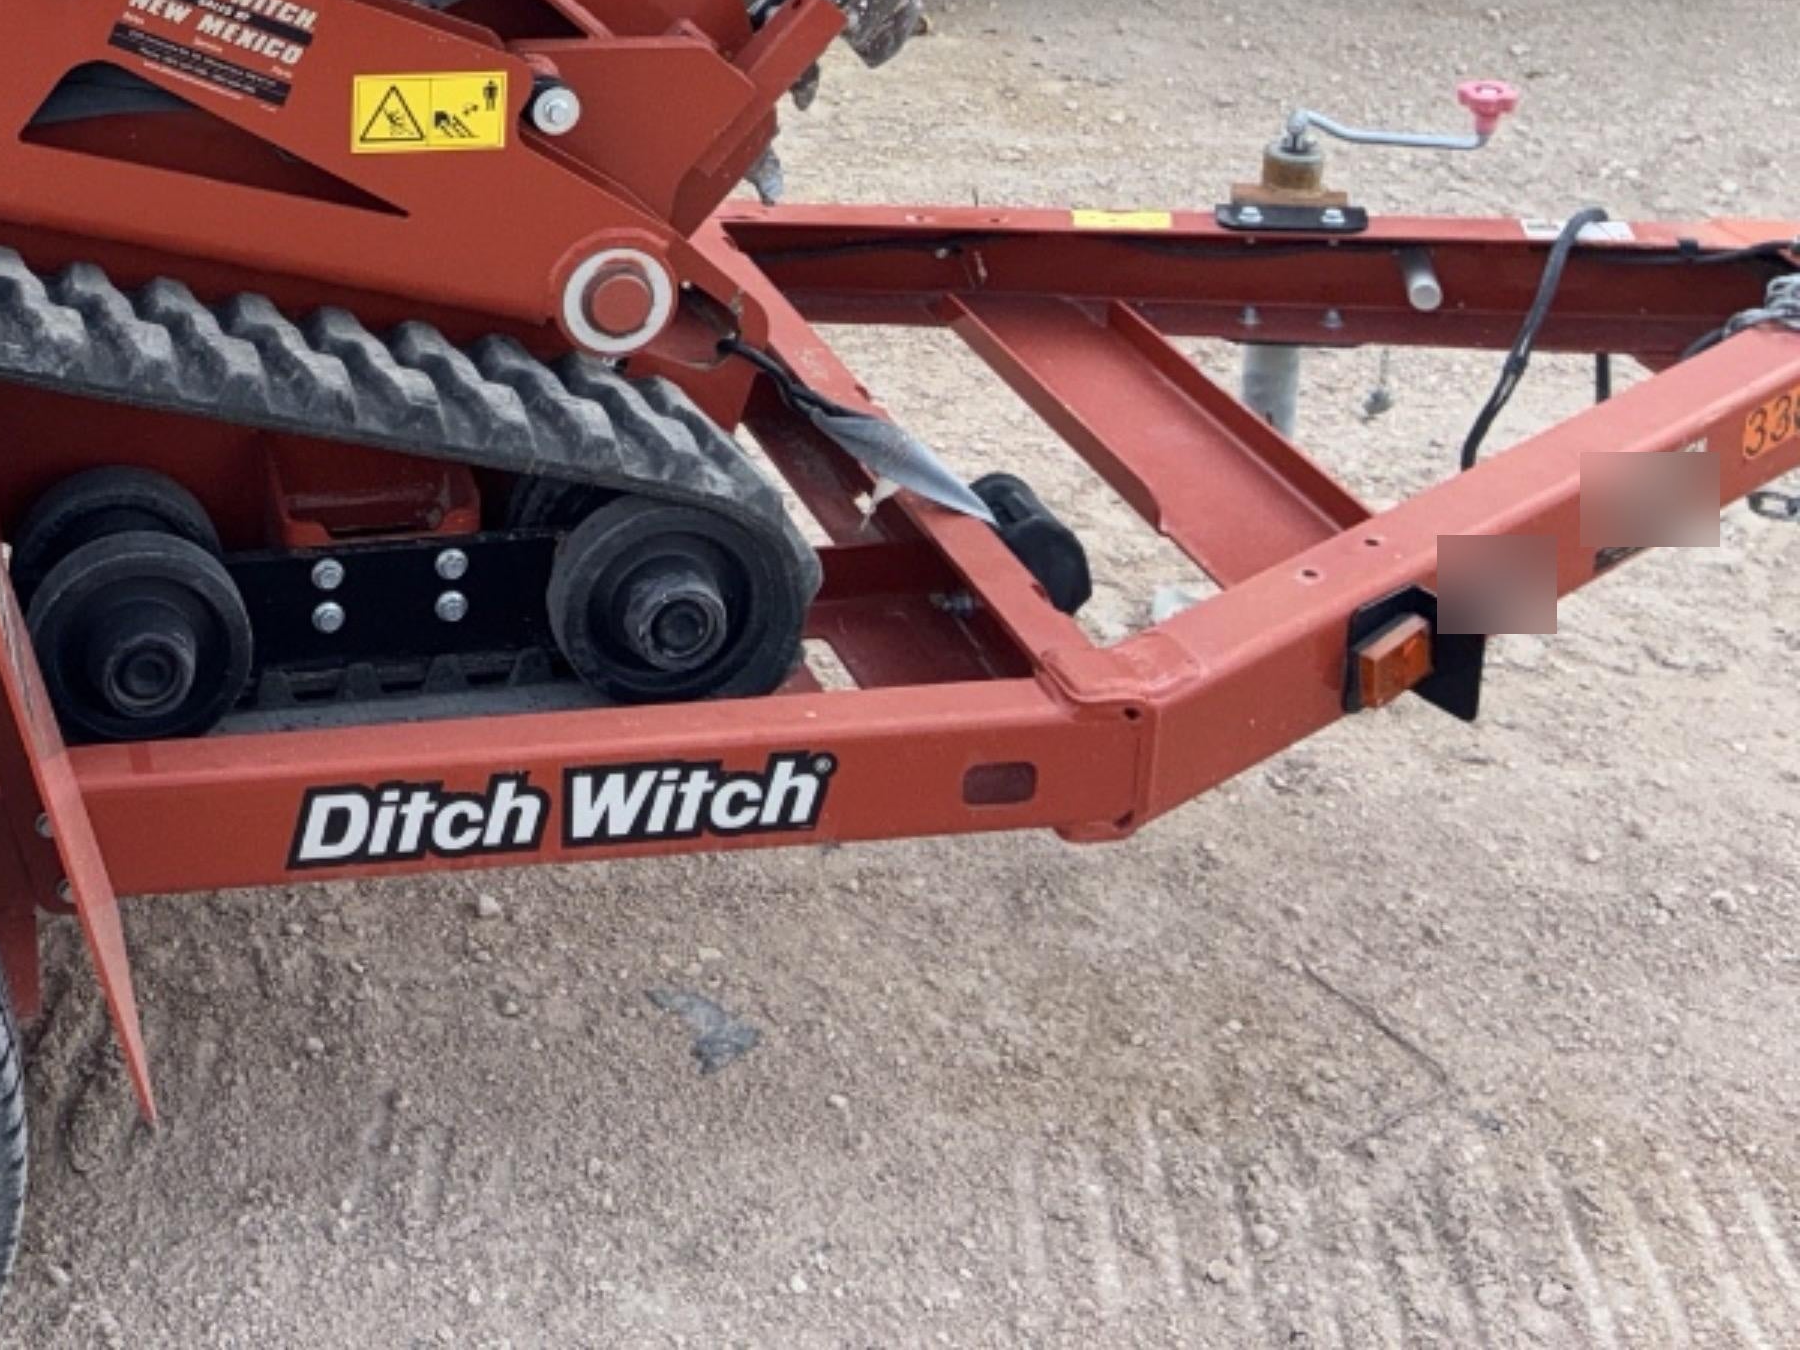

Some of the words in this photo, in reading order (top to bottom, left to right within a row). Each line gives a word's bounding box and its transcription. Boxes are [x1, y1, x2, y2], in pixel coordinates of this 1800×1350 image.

[196, 14, 305, 65] MEXICO
[1745, 391, 1800, 455] 33
[298, 780, 542, 862] Ditch
